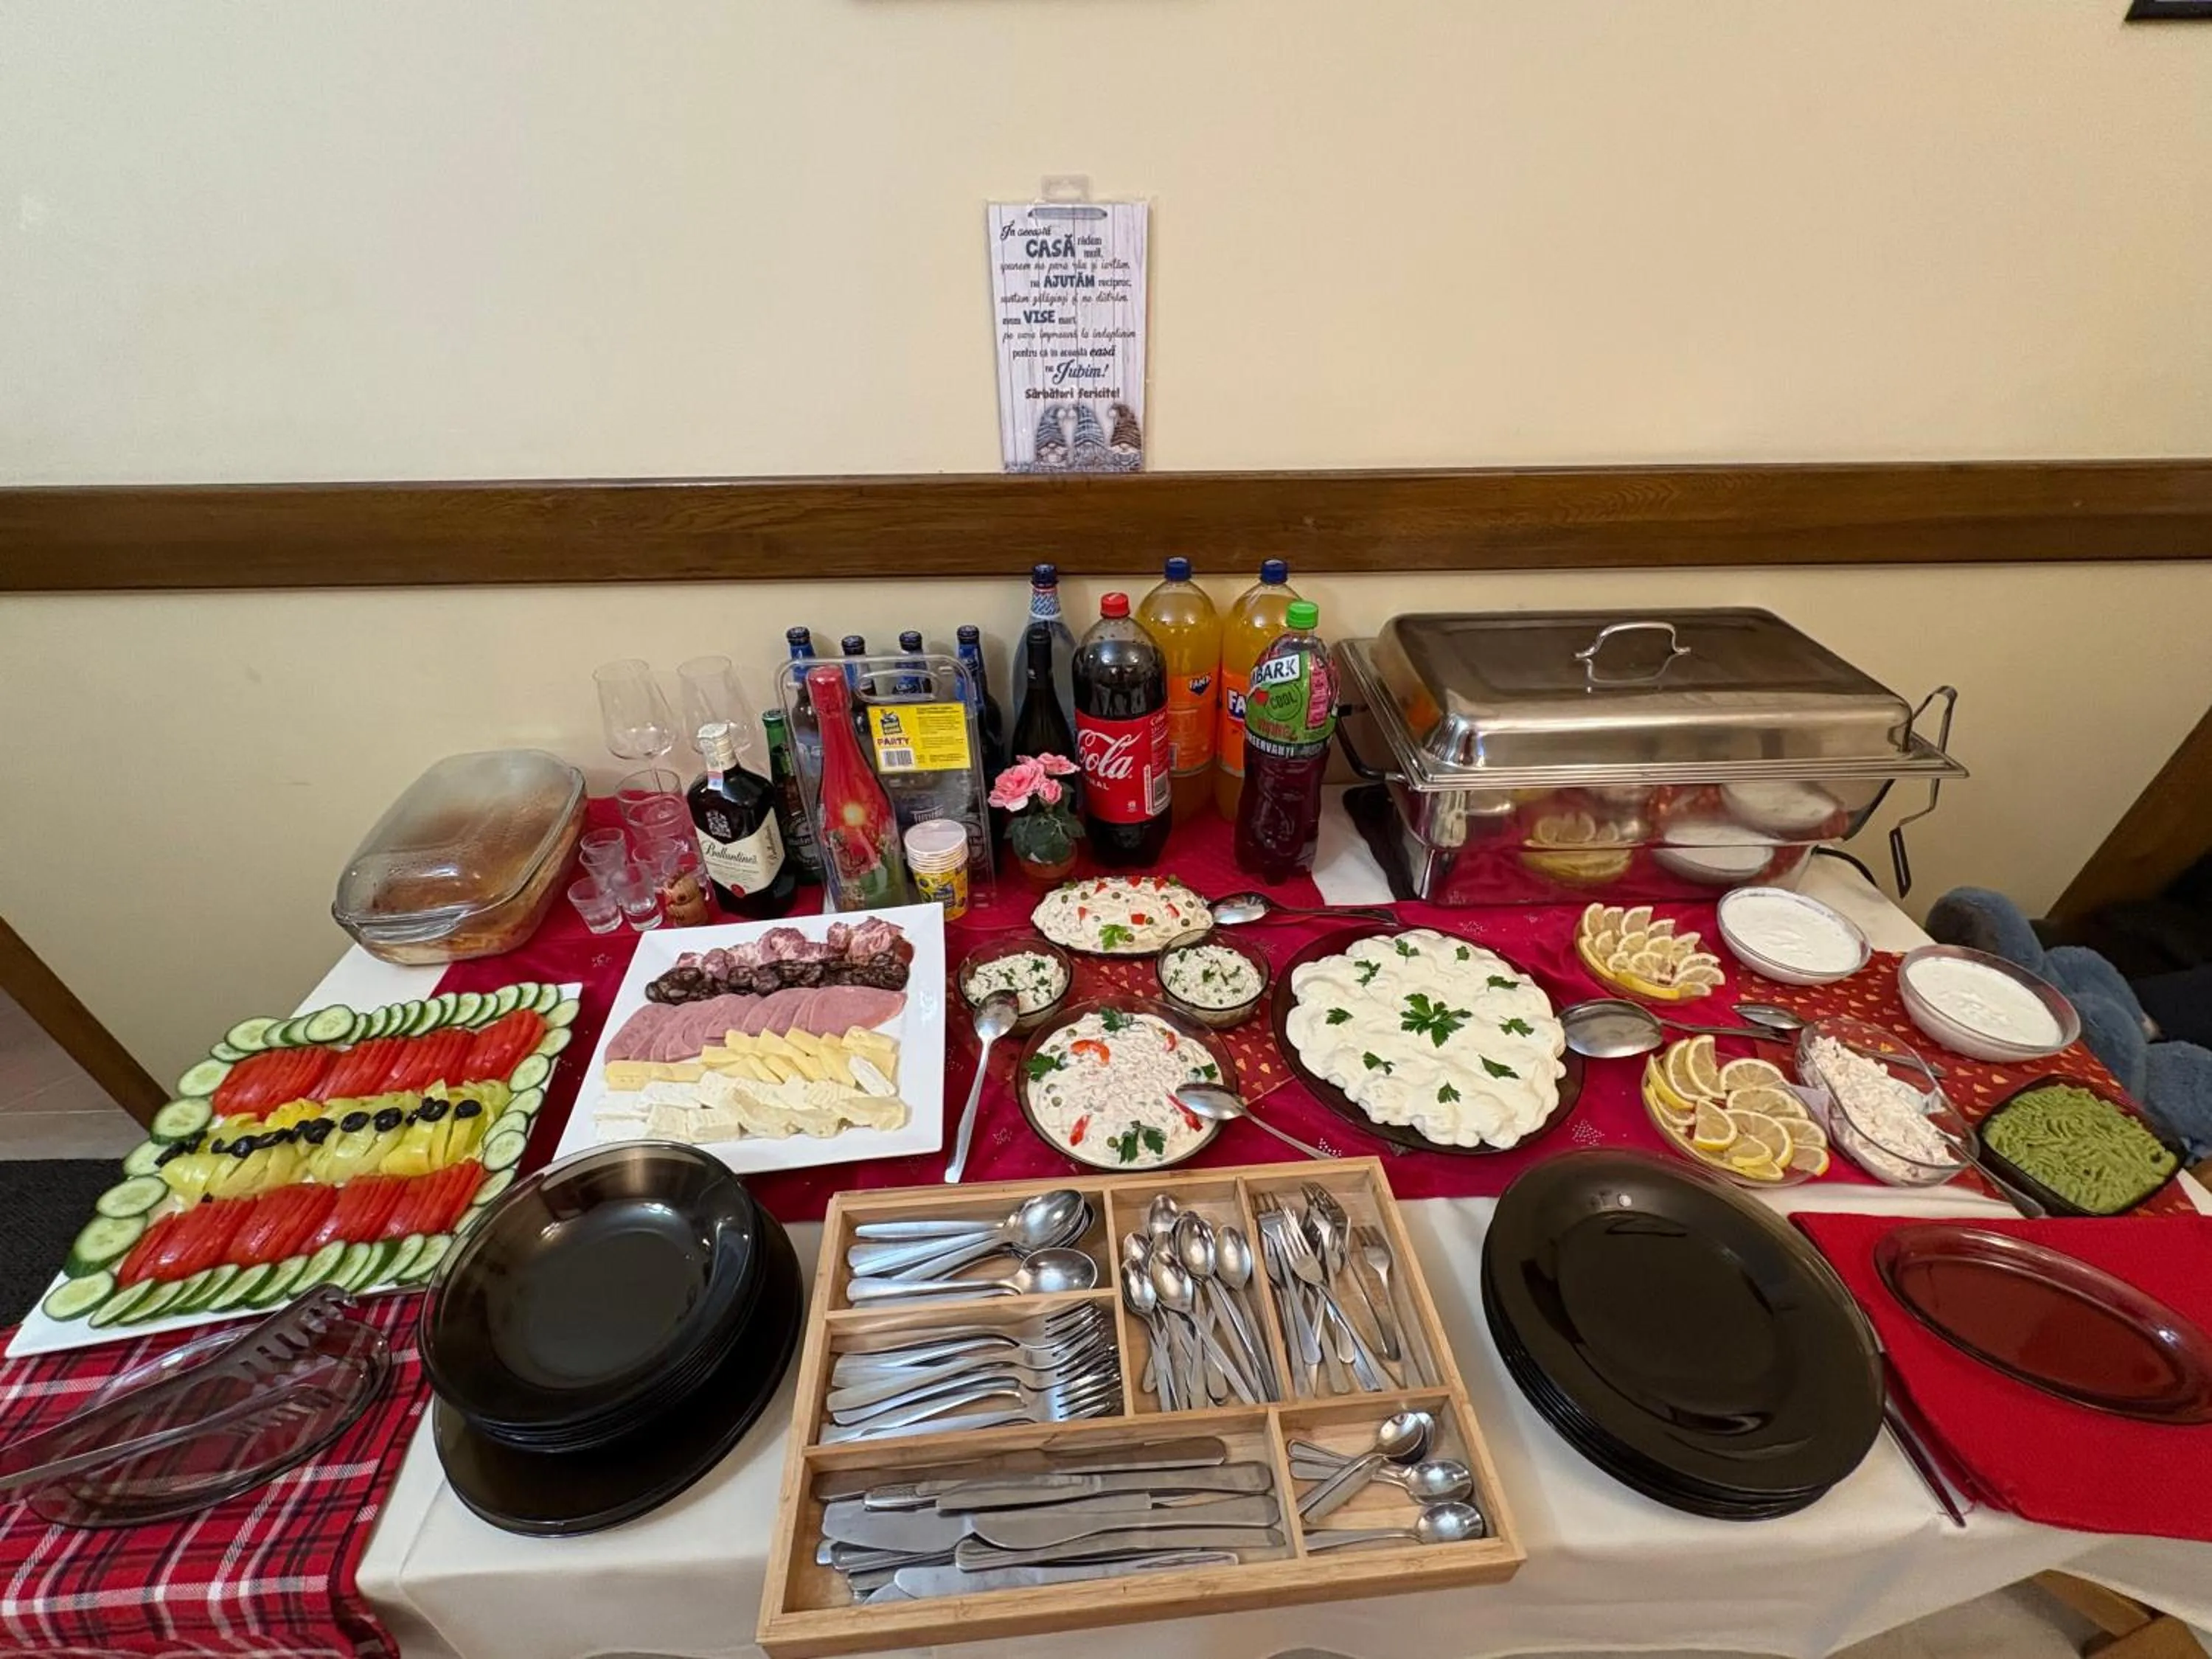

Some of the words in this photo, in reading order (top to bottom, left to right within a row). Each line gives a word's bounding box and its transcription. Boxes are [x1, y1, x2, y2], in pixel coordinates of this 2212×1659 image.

[1026, 233, 1075, 258] CASĂ
[1044, 271, 1094, 288] AJUTĂM
[1023, 310, 1055, 324] VISE
[1270, 690, 1298, 711] COOL
[877, 737, 909, 746] PARTY
